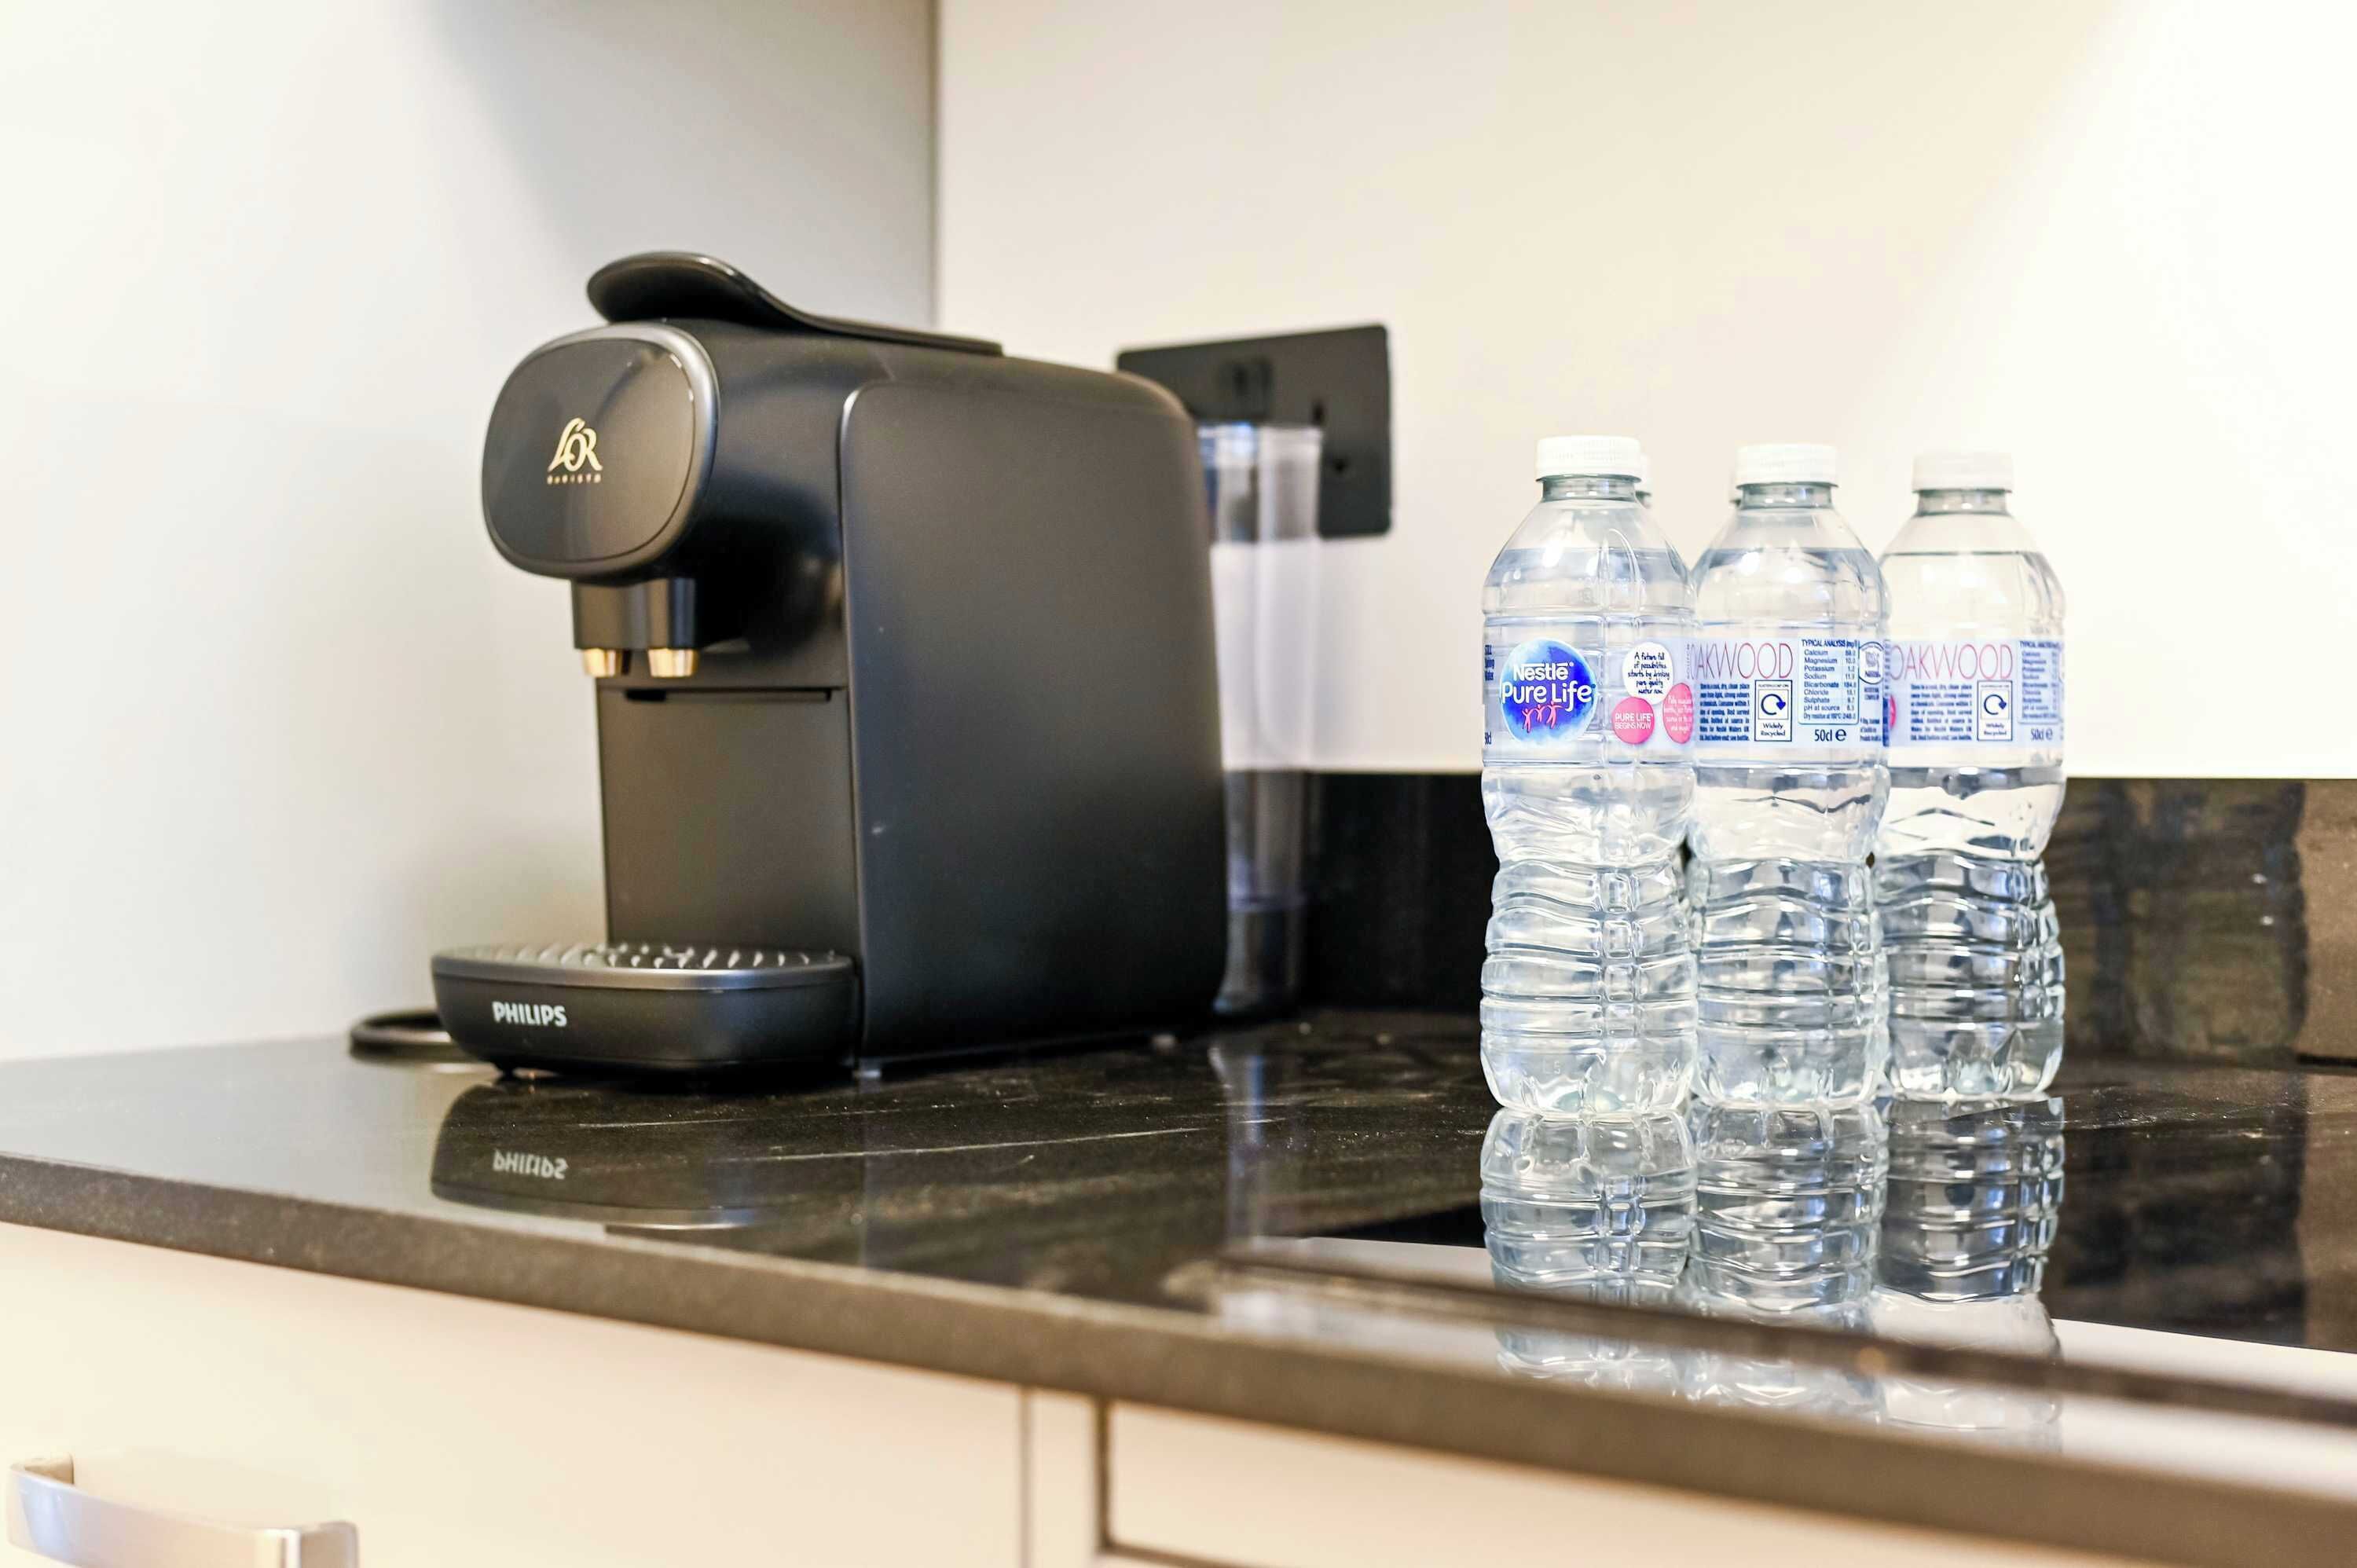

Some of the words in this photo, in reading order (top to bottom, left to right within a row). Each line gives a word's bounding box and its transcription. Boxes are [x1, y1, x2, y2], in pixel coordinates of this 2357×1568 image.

[1634, 651, 1640, 660] A
[1645, 669, 1651, 680] by
[1501, 681, 1547, 704] Pure
[1552, 680, 1592, 712] Life
[1615, 713, 1634, 721] PURE
[1636, 713, 1651, 721] LIFE
[1814, 729, 1832, 742] 50cl
[492, 1002, 567, 1027] PHILIPS
